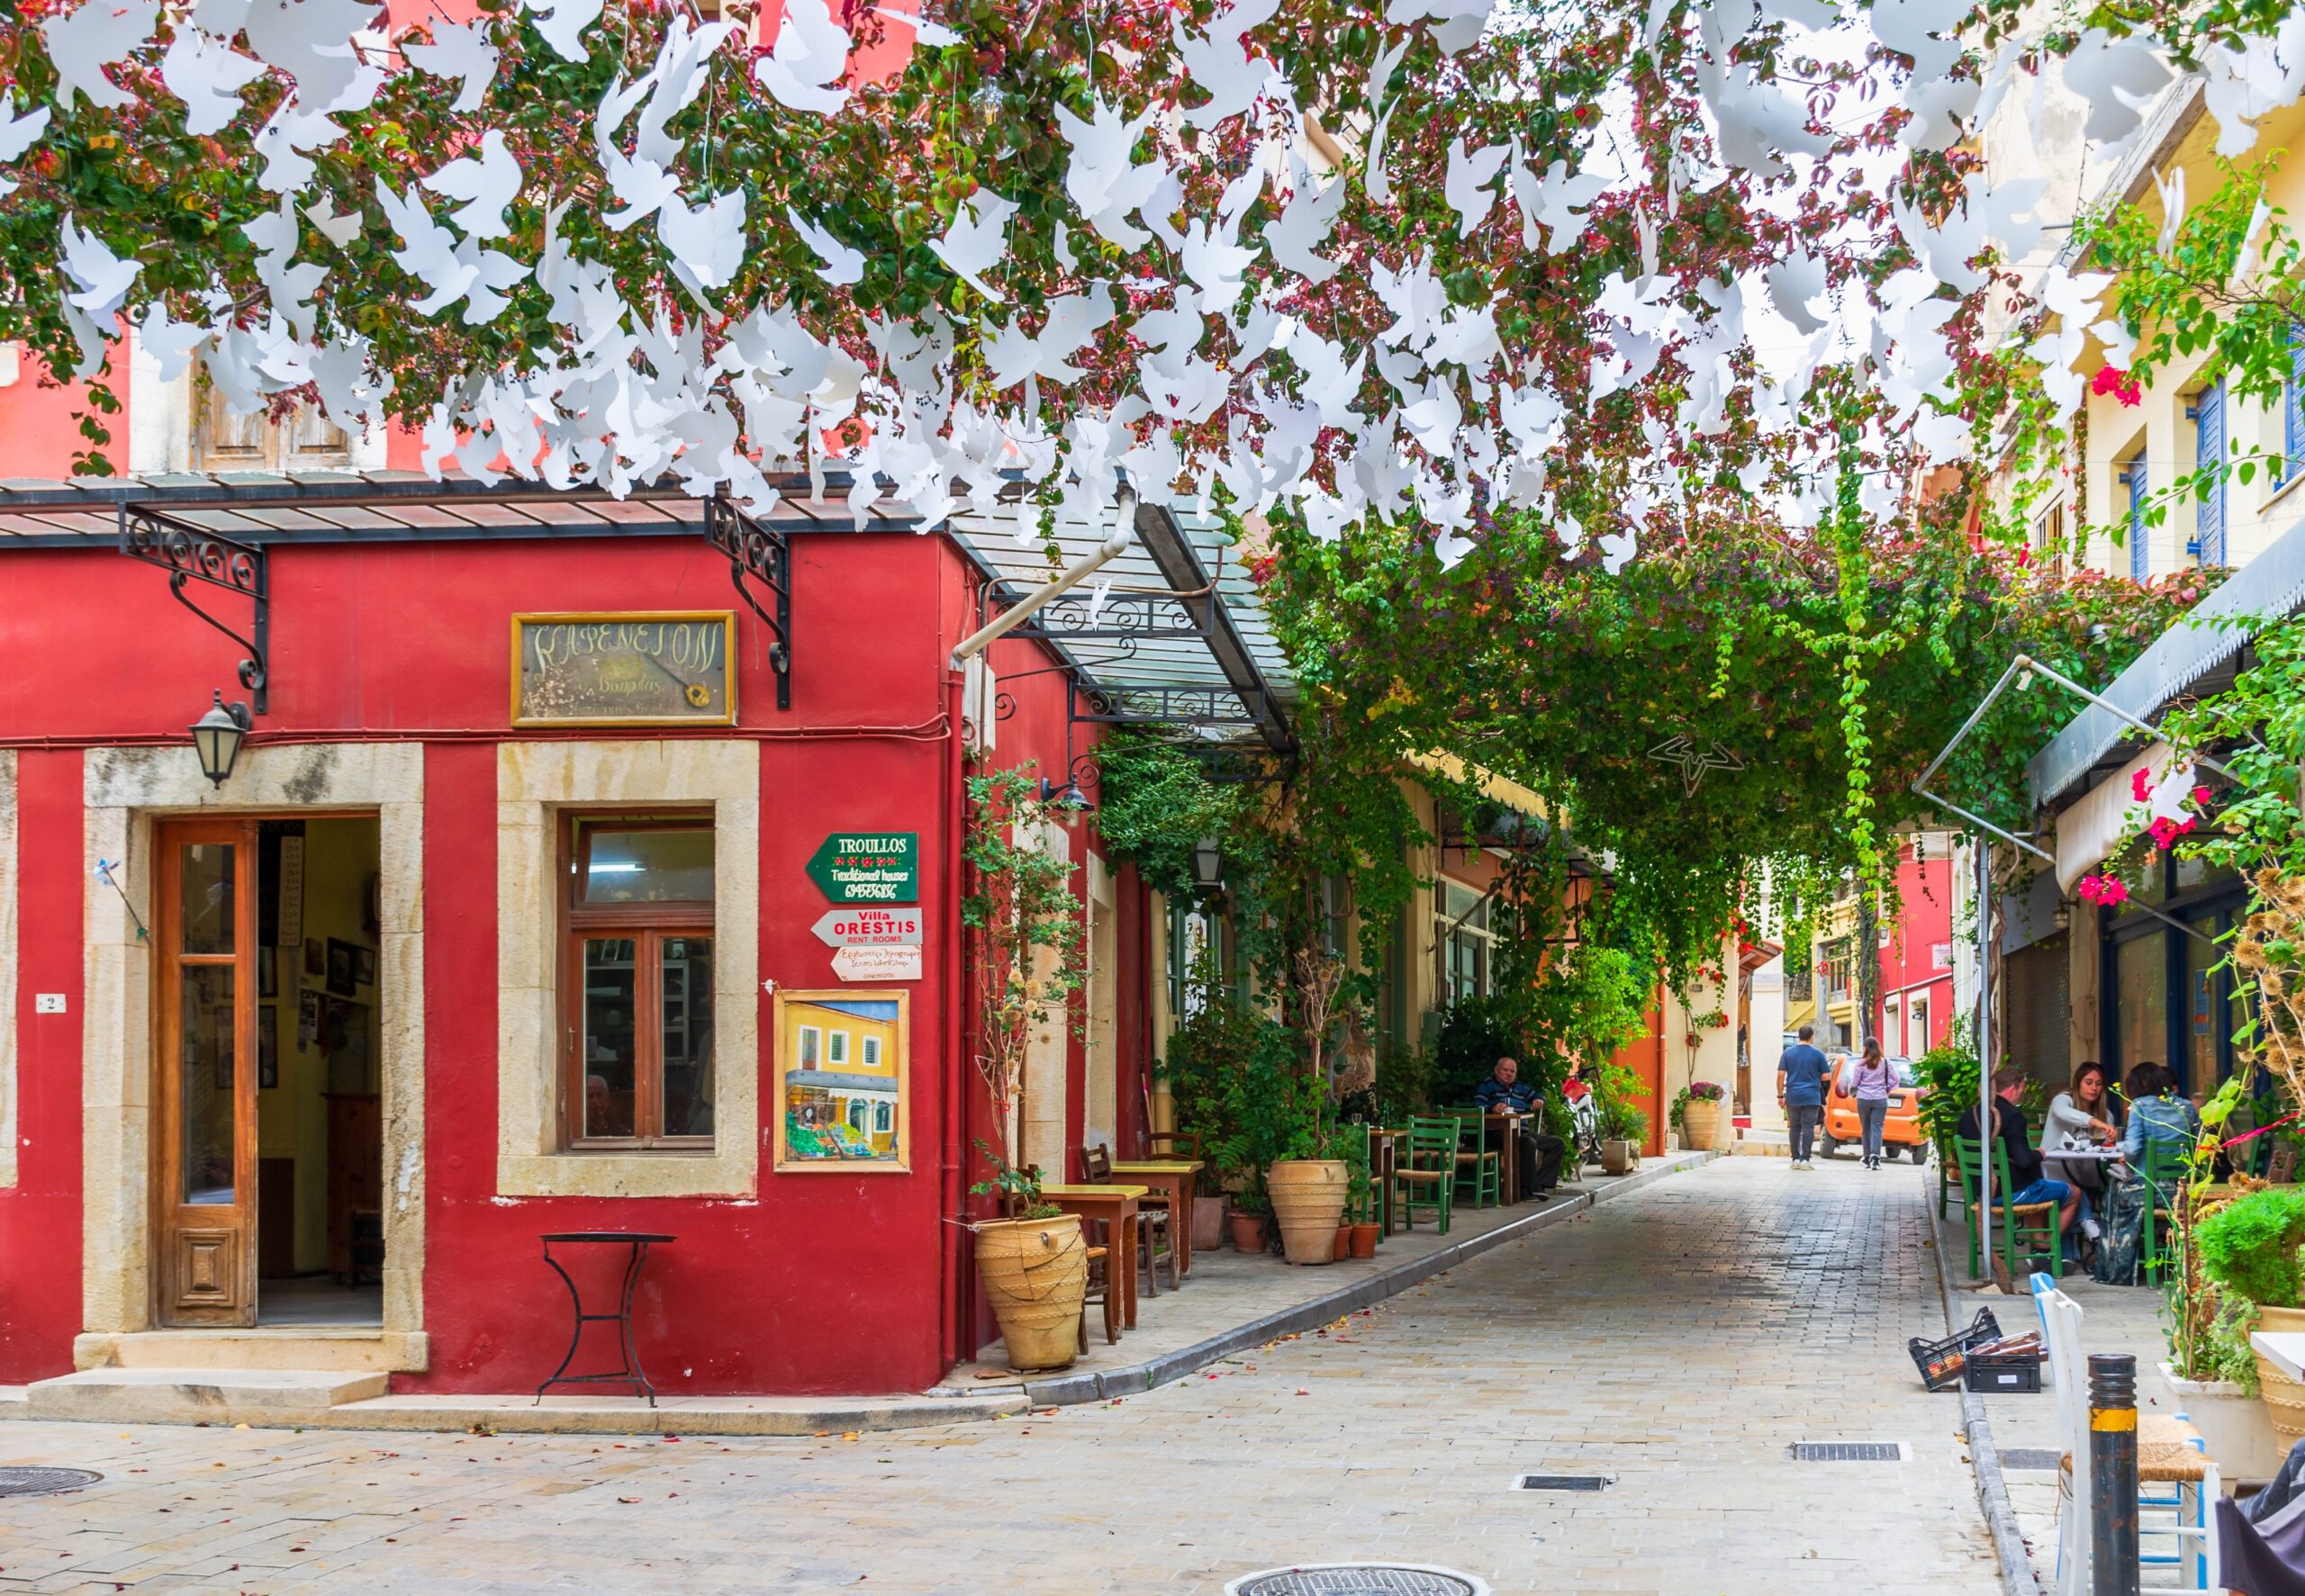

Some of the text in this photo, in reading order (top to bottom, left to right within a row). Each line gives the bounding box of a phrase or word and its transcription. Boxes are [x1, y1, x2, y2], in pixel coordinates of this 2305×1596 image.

[838, 838, 907, 853] TROULLOS
[831, 867, 908, 882] Traditional houses
[858, 912, 890, 921] Villa
[834, 921, 916, 935] ORESTIS
[847, 935, 902, 944] RENT ROOMS
[47, 996, 55, 1009] 2
